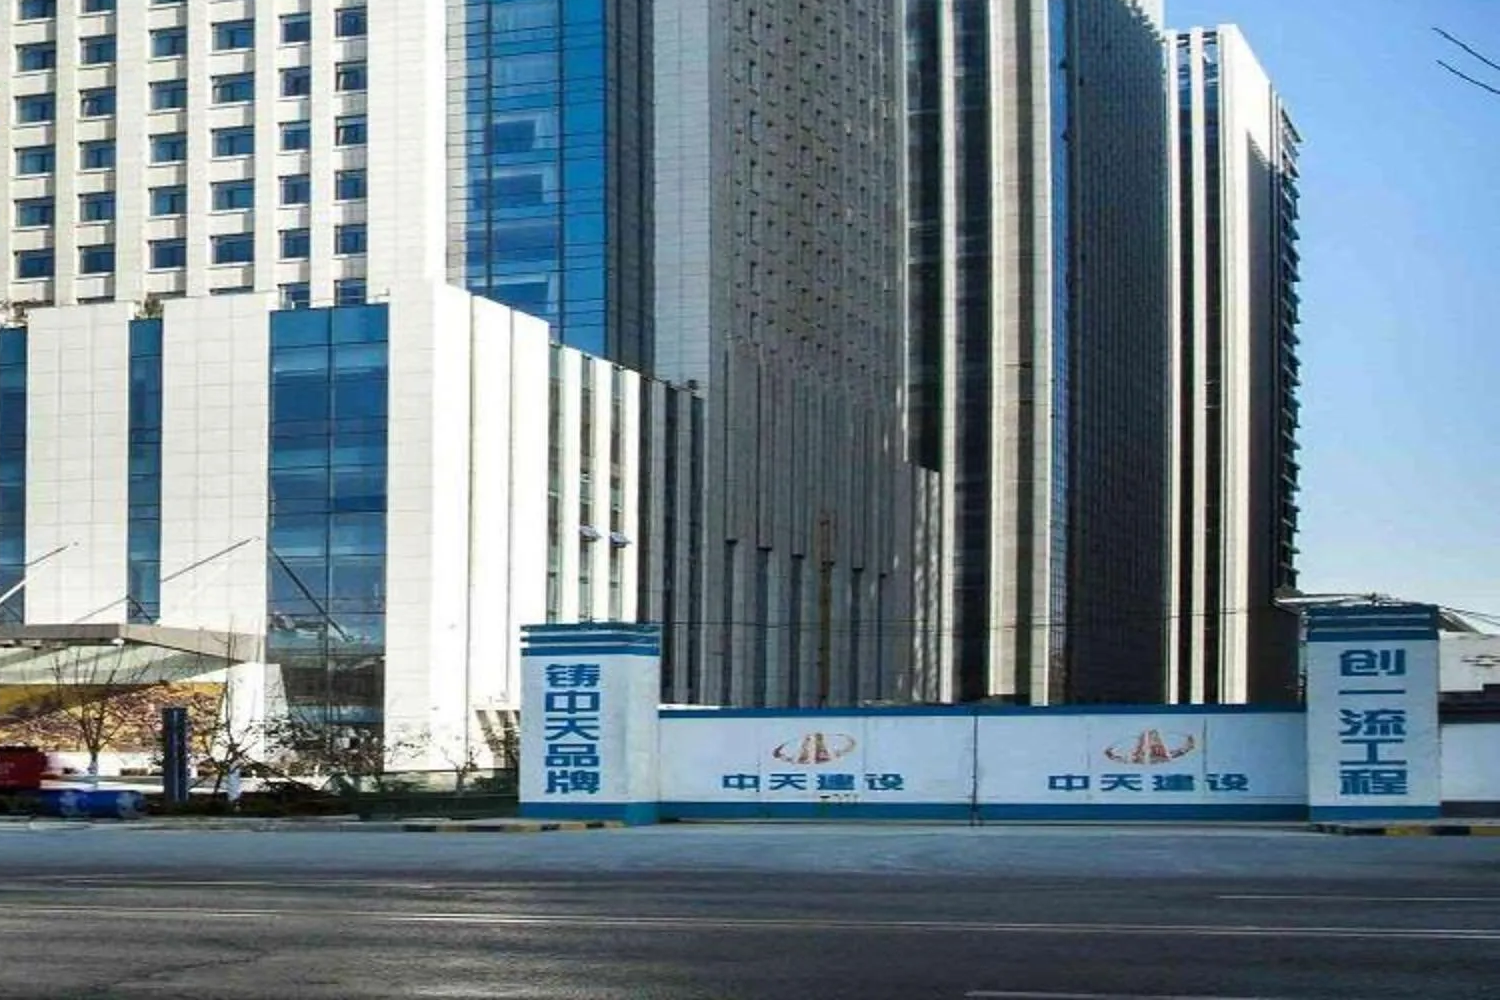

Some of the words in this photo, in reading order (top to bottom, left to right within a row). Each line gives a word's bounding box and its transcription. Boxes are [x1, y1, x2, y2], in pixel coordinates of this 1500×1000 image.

[544, 663, 601, 794] 铸中天品牌
[1338, 648, 1408, 796] 创一流工程
[722, 772, 905, 793] 中天建设
[1047, 773, 1250, 792] 中天建设
